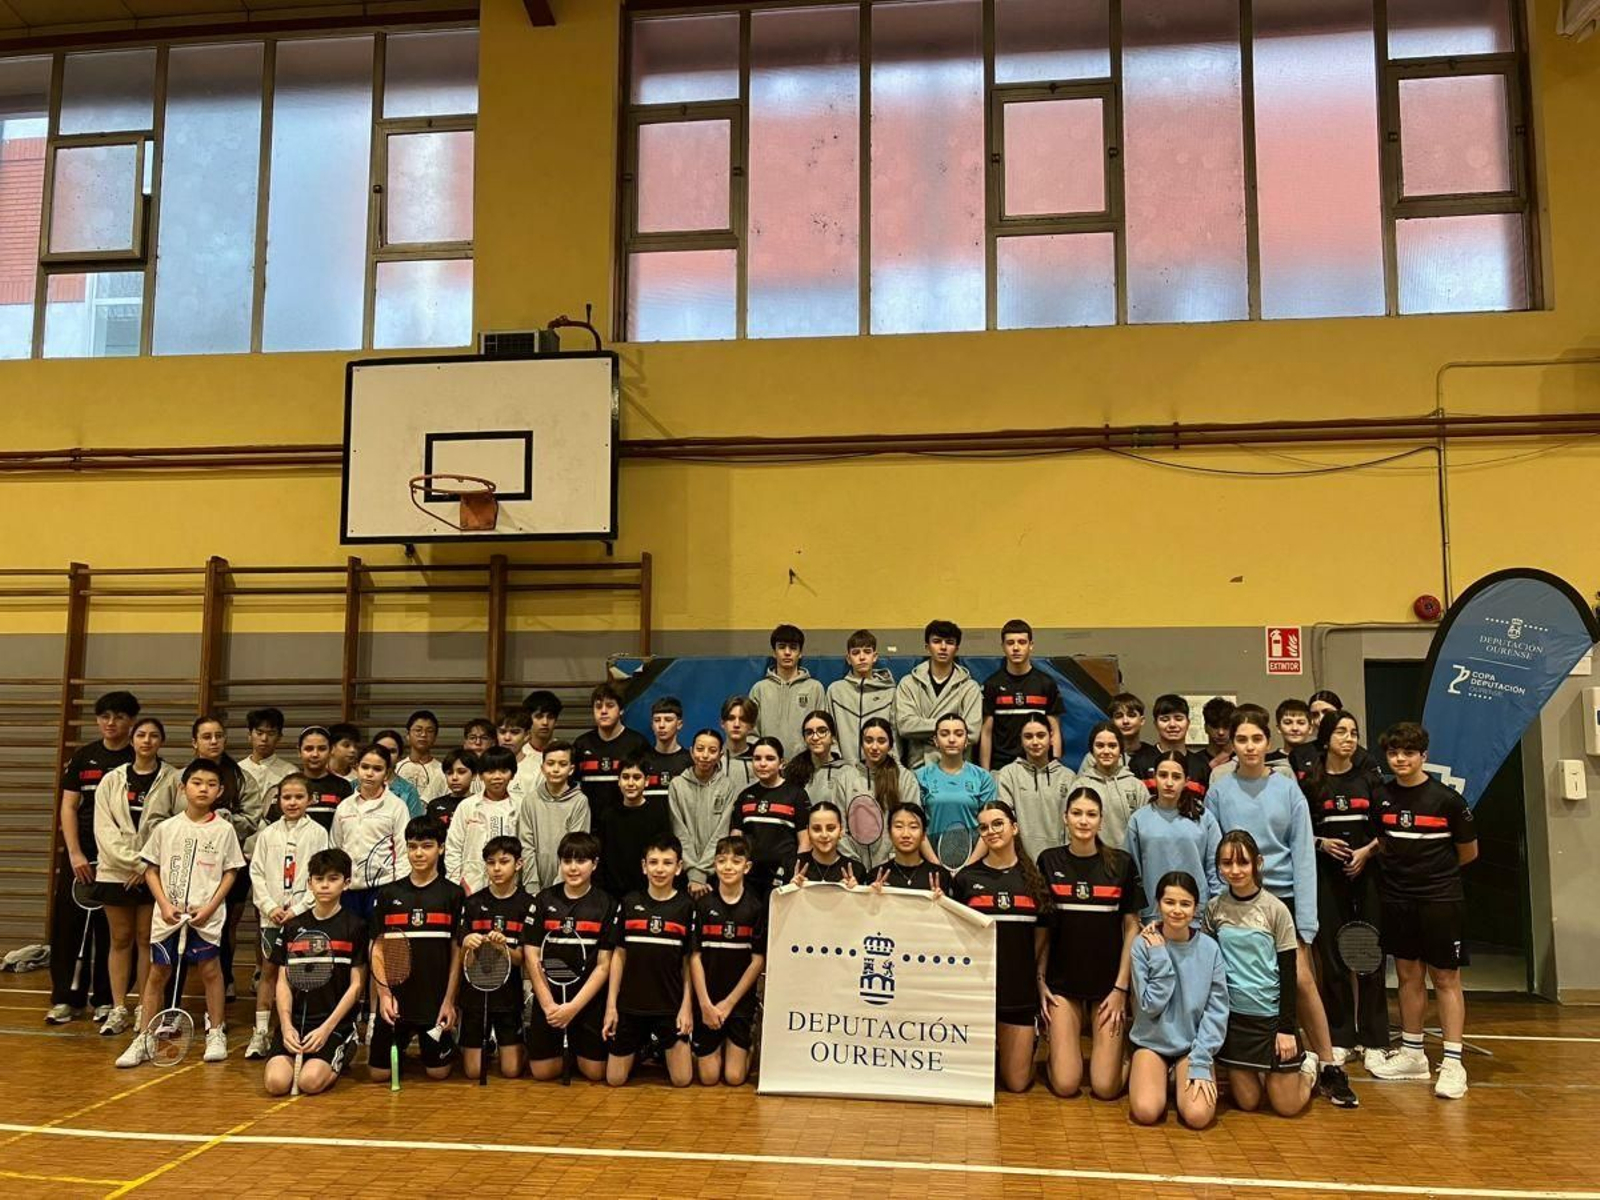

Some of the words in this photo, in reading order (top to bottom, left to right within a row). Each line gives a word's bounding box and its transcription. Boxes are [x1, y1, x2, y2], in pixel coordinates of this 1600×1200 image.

[1479, 635, 1544, 653] DEPUTACIÓN
[1485, 644, 1533, 660] OURENSE
[1269, 662, 1299, 670] EXTINTOR
[1471, 671, 1496, 681] COPA
[1470, 678, 1526, 696] DEPUTACIÓN
[787, 1011, 969, 1044] DEPUTACIÓN
[810, 1041, 944, 1072] OURENSE
